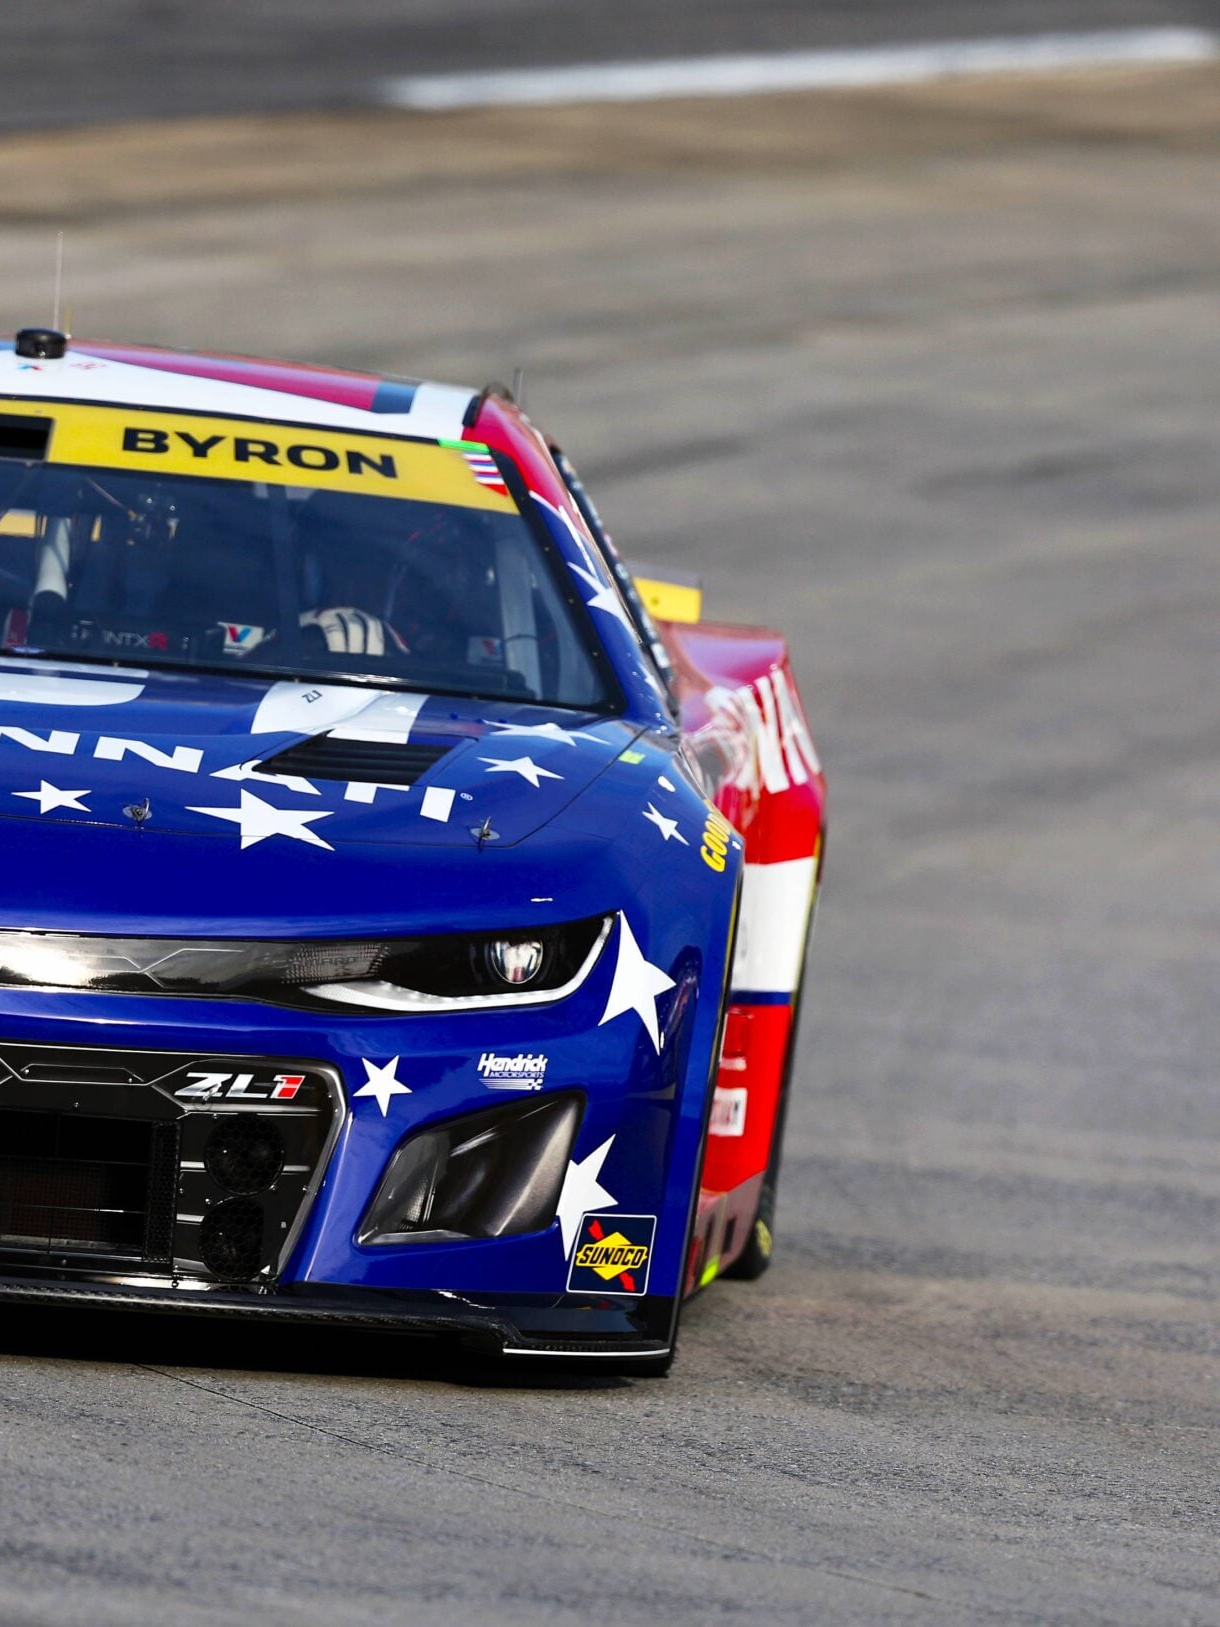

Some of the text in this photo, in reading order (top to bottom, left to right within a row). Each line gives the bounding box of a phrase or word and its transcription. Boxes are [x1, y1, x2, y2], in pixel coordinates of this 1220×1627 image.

[123, 427, 398, 479] BYRON
[700, 799, 732, 873] GOOD
[477, 1053, 548, 1077] Hendrick
[174, 1072, 306, 1099] ZL1
[579, 1246, 645, 1266] SUNOCO
